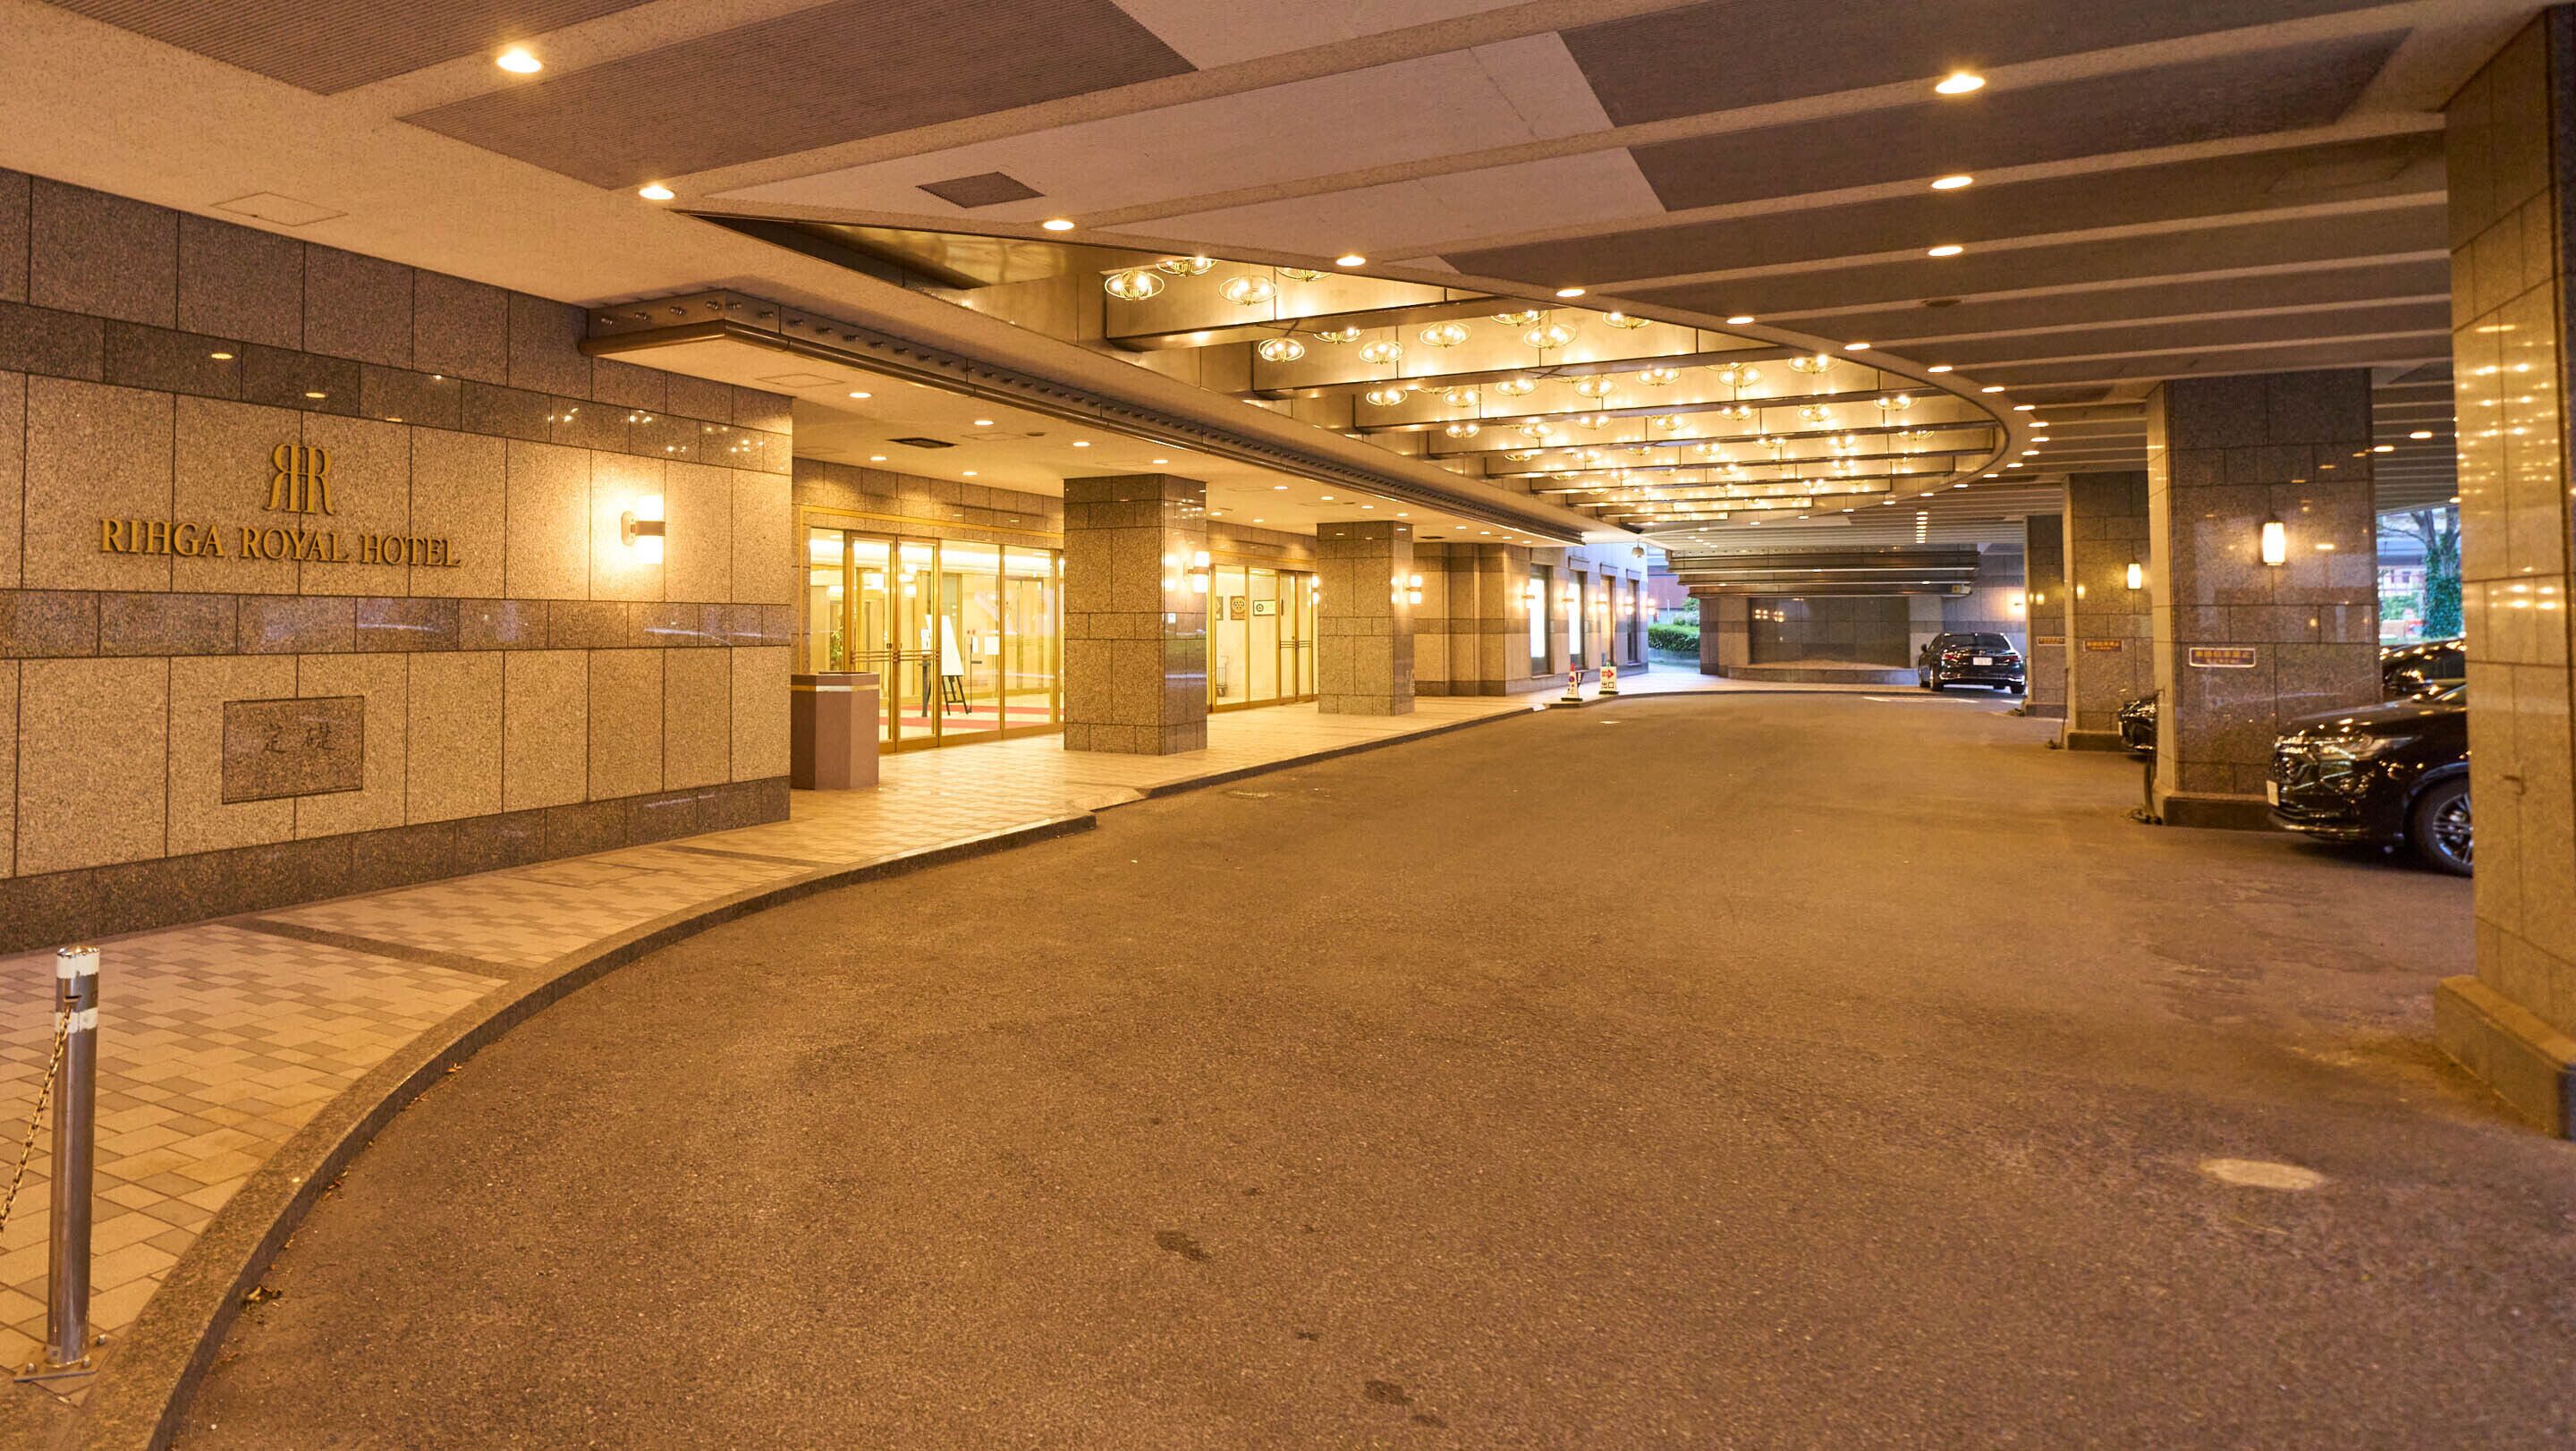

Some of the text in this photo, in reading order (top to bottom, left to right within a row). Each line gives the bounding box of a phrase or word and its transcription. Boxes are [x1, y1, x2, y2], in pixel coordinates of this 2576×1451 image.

[100, 517, 462, 568] RIHGA ROYAL HOTEL
